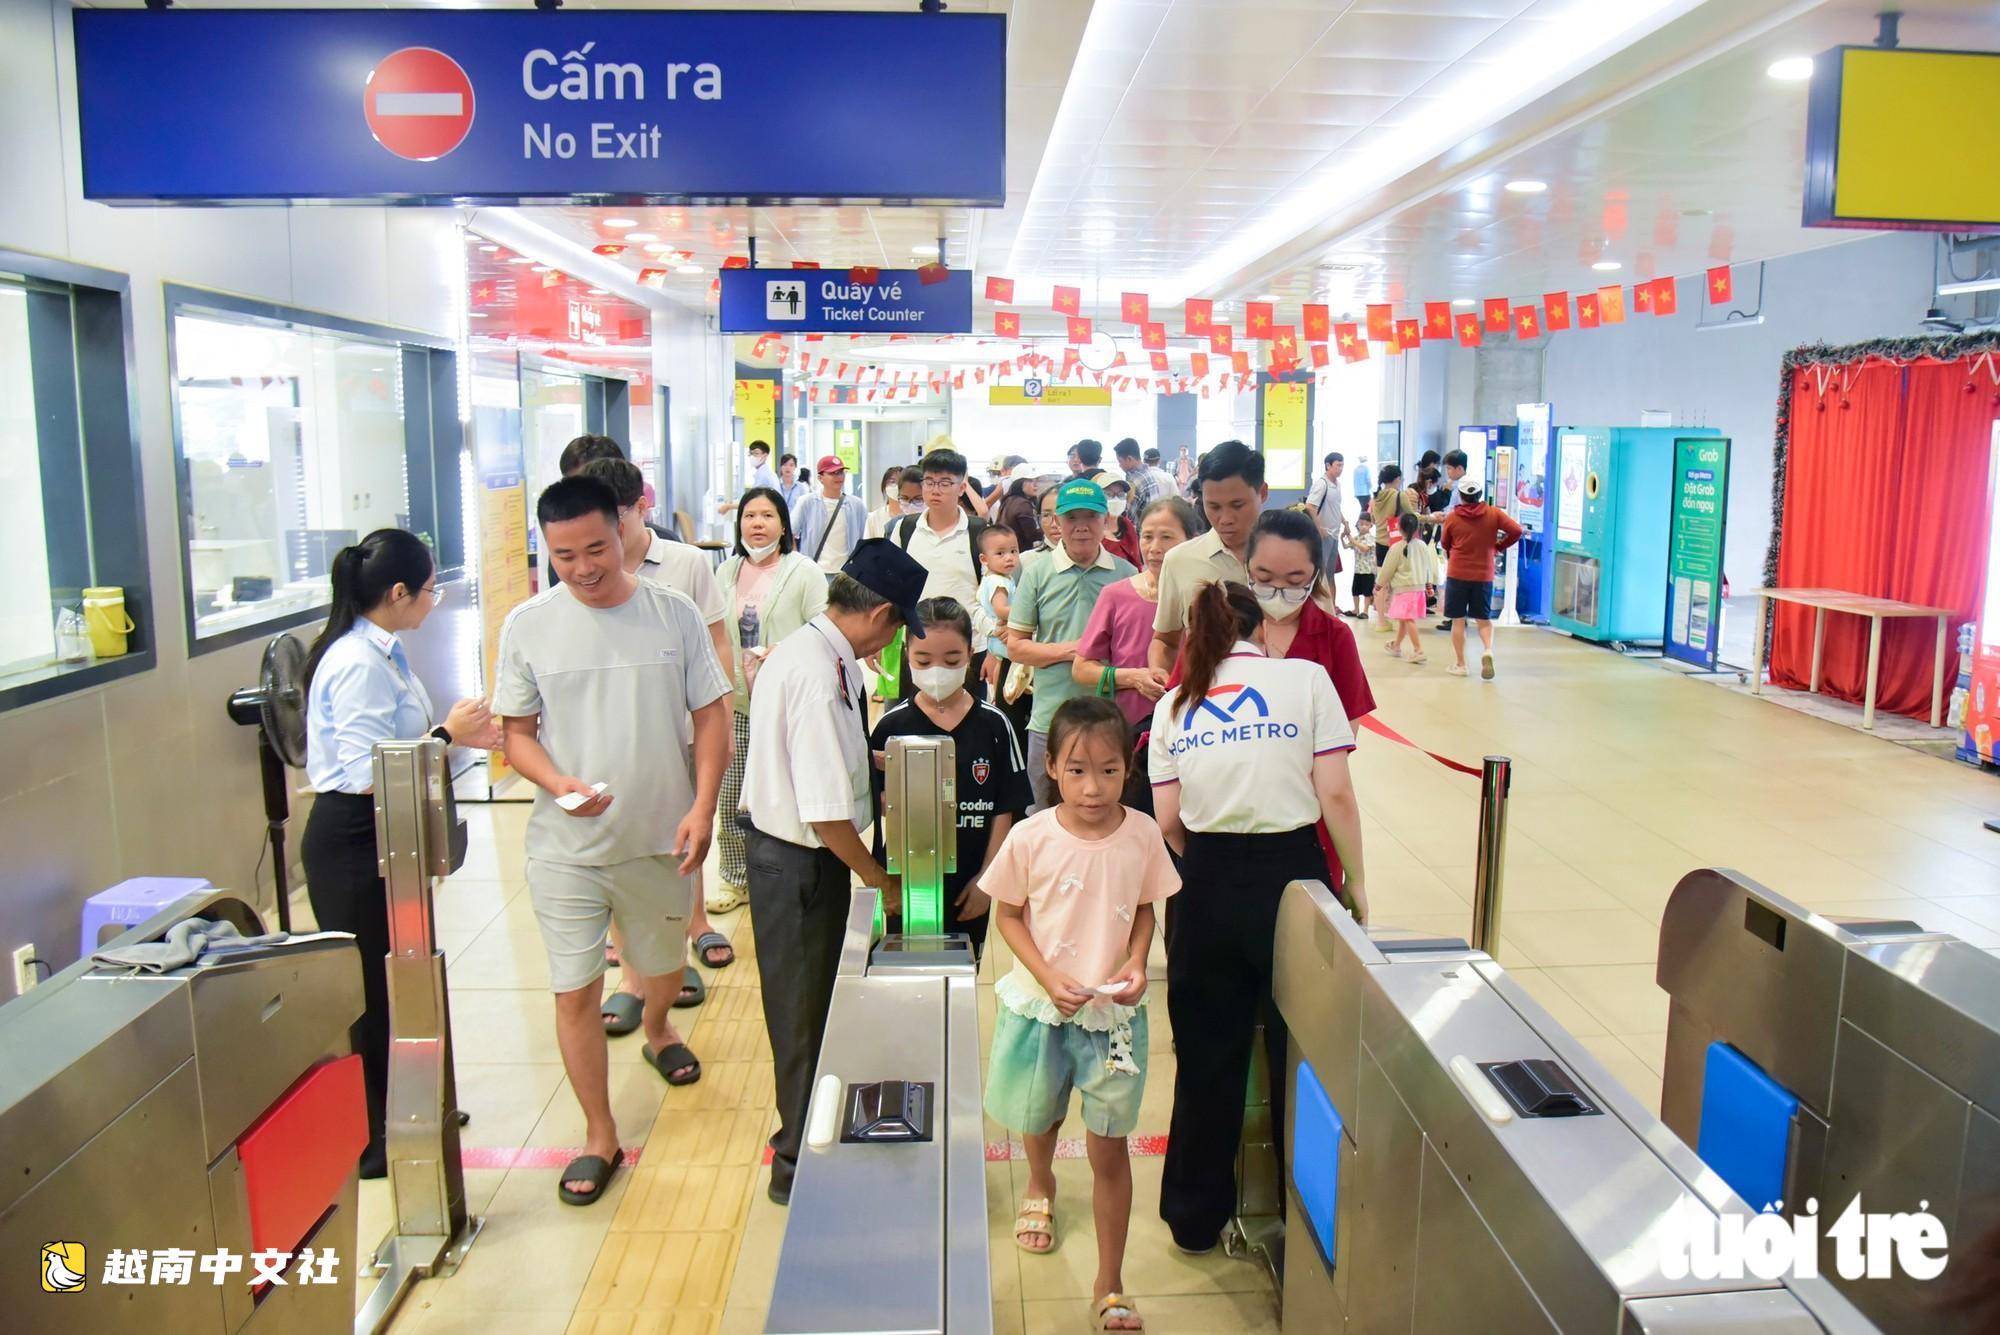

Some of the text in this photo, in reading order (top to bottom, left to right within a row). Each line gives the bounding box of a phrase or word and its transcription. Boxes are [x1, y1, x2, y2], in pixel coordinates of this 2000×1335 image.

[522, 41, 722, 100] Cấm ra
[523, 122, 662, 159] No Exit
[879, 281, 902, 300] vé
[822, 307, 925, 321] Ticket Counter
[1699, 448, 1719, 462] Grab
[1697, 483, 1715, 496] Grab
[1221, 723, 1299, 744] METRO
